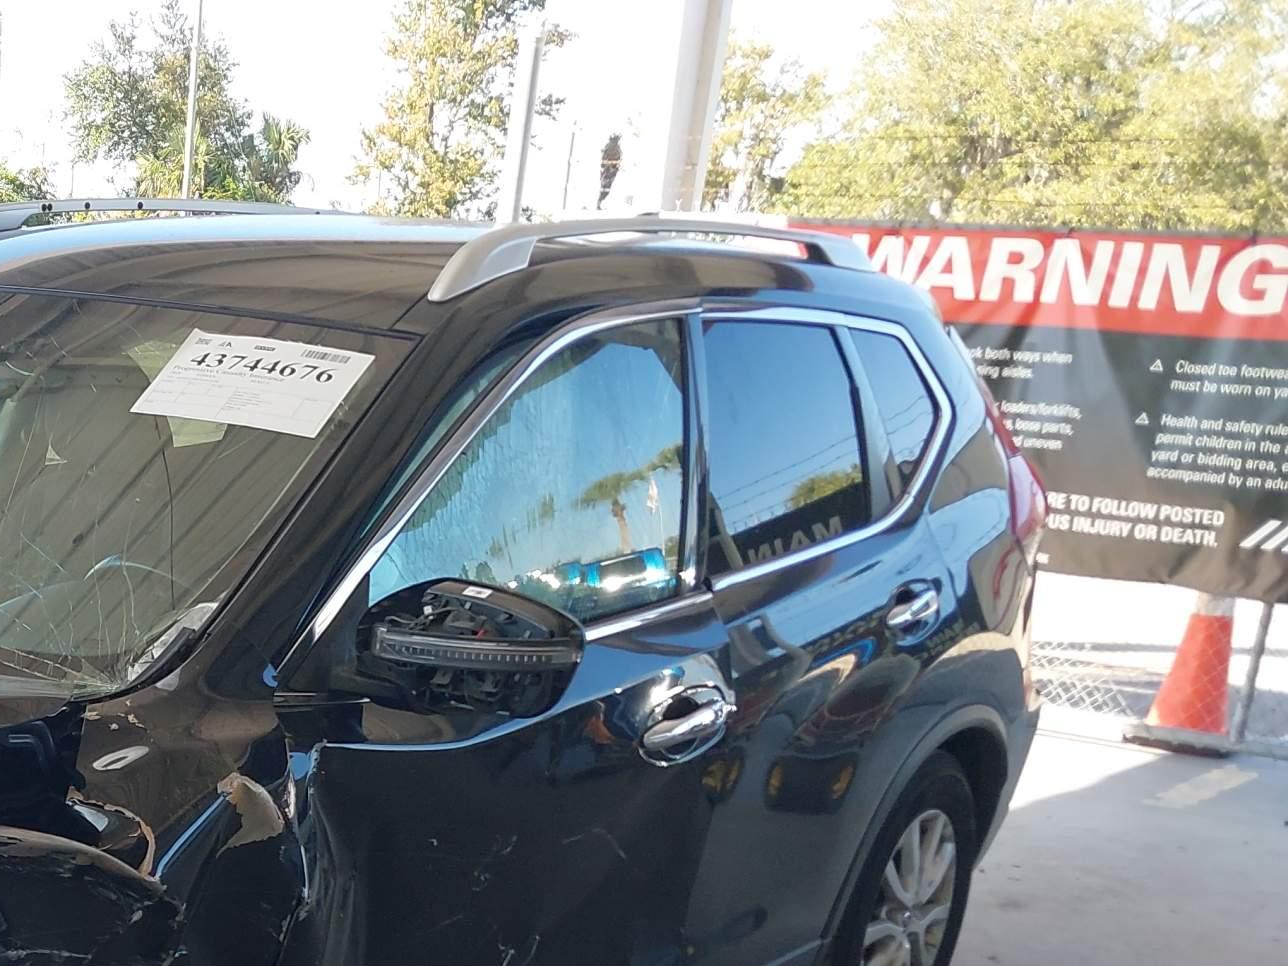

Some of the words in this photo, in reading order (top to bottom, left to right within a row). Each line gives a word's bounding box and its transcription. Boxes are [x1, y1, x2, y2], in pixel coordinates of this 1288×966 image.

[851, 233, 1288, 316] WARNING
[190, 352, 339, 384] 43744676
[1175, 360, 1216, 376] Closed
[1218, 364, 1237, 377] toe
[1240, 364, 1288, 380] footwea
[1170, 379, 1200, 392] must
[1203, 380, 1217, 393] be
[1220, 384, 1252, 395] worn
[1255, 385, 1271, 397] on
[1160, 413, 1198, 430] Health
[1200, 418, 1223, 432] and
[1225, 420, 1263, 437] safety
[1265, 423, 1288, 436] rule
[1155, 433, 1193, 446] permit
[1195, 435, 1242, 450] children
[1244, 438, 1256, 452] in
[1260, 440, 1281, 454] the
[1152, 449, 1179, 462] yard
[1180, 452, 1195, 464] or
[1197, 452, 1242, 471] bidding
[1245, 458, 1277, 474] area,
[1147, 466, 1225, 484] accompanied
[1228, 472, 1243, 488] by
[1246, 477, 1261, 488] an
[1069, 494, 1090, 513] TO
[1091, 498, 1158, 520] FOLLOW
[1159, 504, 1225, 527] POSTED
[1072, 516, 1132, 538] INJURY
[1134, 524, 1157, 542] OR
[1160, 525, 1219, 548] DEATH.
